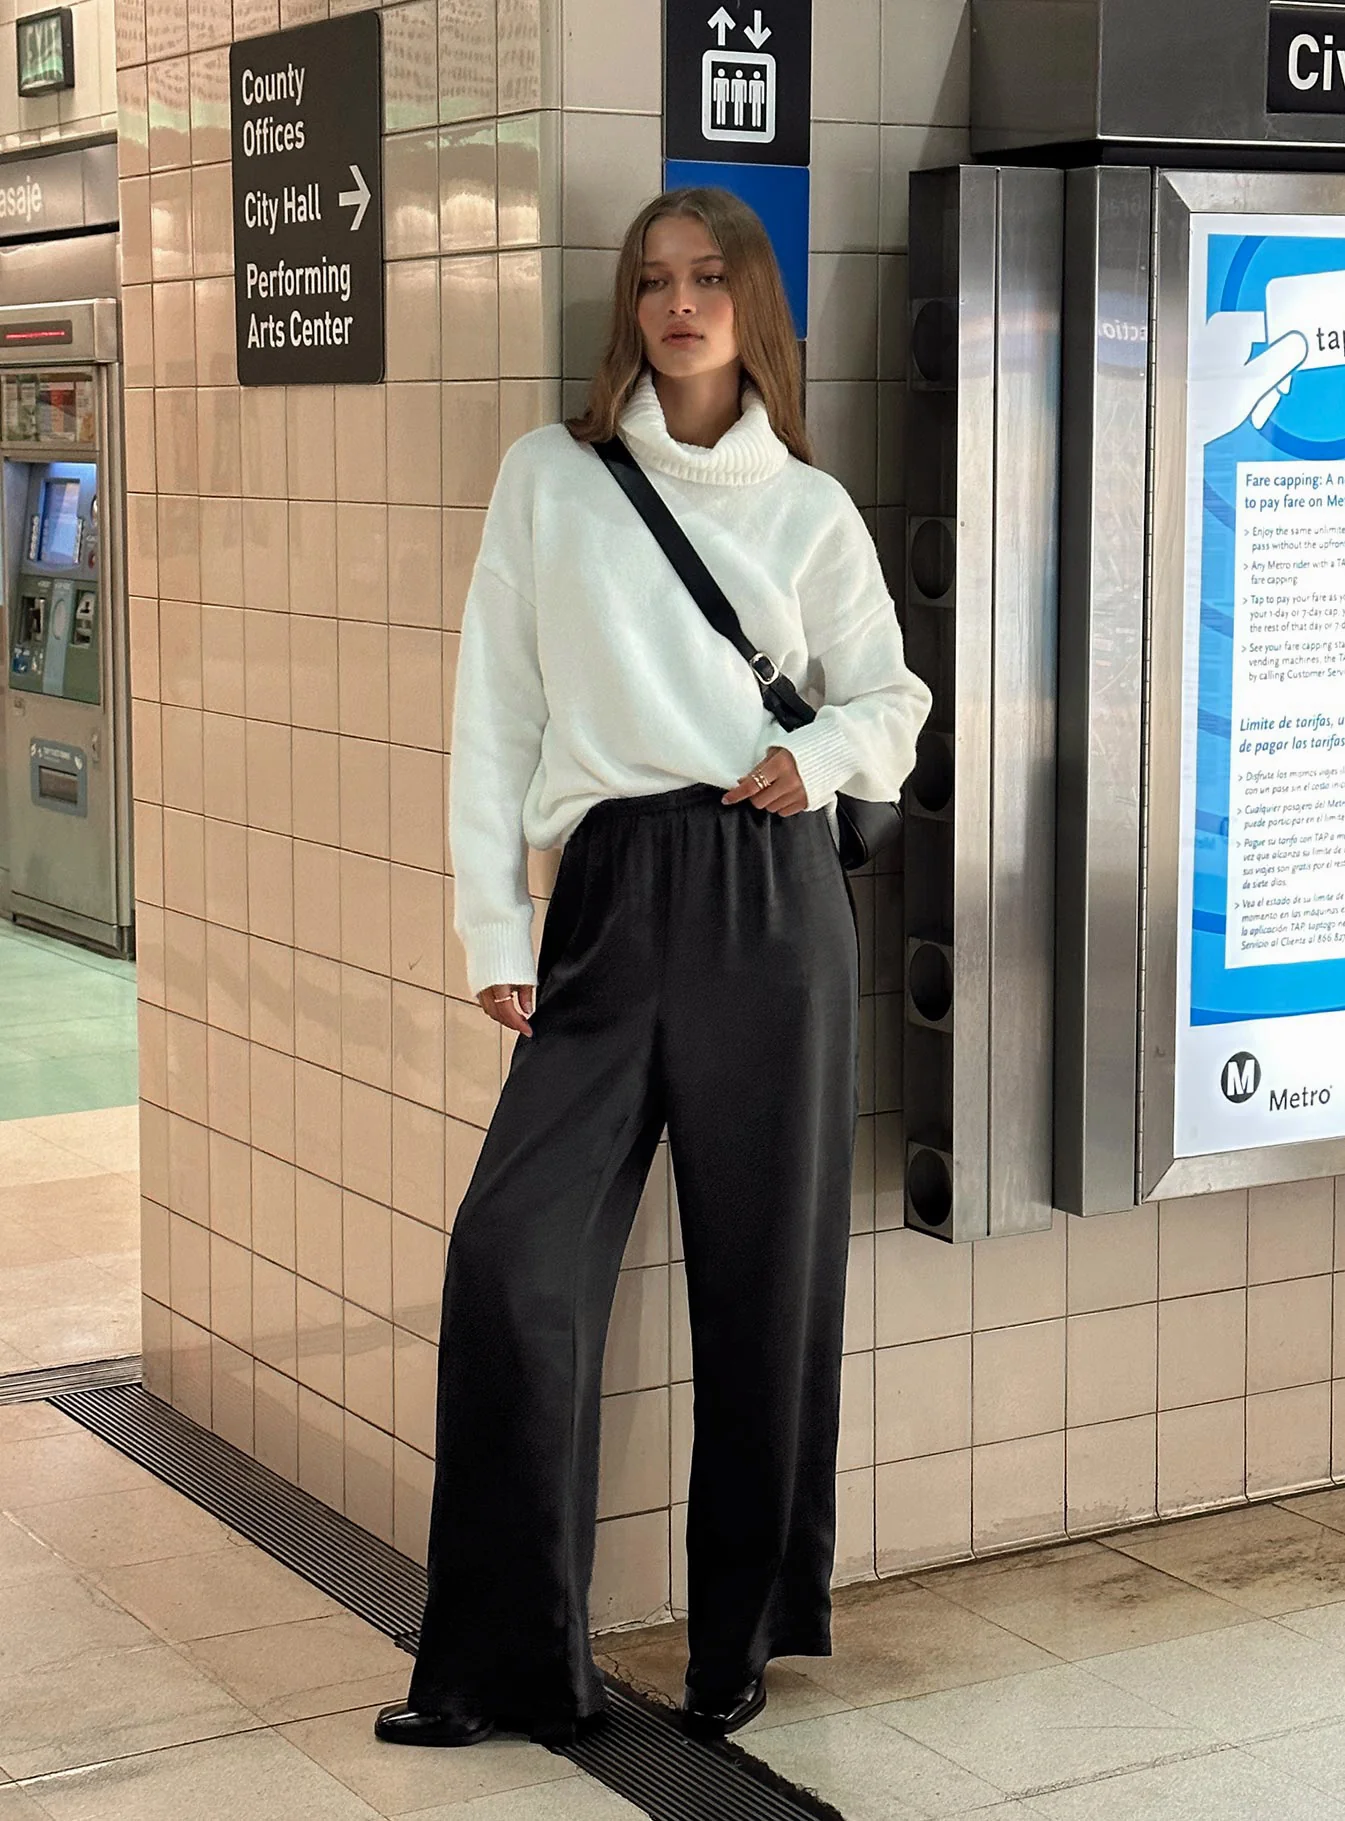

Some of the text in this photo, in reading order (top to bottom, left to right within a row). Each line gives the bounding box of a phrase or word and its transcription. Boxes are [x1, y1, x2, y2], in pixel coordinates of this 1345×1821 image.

[242, 63, 305, 106] County
[243, 116, 305, 157] Offices
[0, 175, 42, 222] asaje
[244, 183, 322, 235] City Hall
[246, 256, 351, 301] Performing
[247, 310, 354, 348] Arts Center
[1316, 327, 1345, 357] ta
[1246, 474, 1270, 487] Fare
[1274, 473, 1322, 490] capping:
[1326, 473, 1333, 485] A
[1245, 494, 1345, 512] to pay fare on Me
[1253, 526, 1273, 538] Enjoy
[1276, 527, 1288, 535] the
[1252, 539, 1345, 553] pass without the upfron
[1251, 561, 1265, 572] Any
[1268, 561, 1291, 569] Metro
[1293, 560, 1310, 568] rider
[1251, 574, 1265, 584] fare
[1250, 595, 1264, 606] Tap
[1266, 596, 1274, 604] to
[1277, 596, 1290, 605] pay
[1293, 596, 1310, 604] your
[1312, 592, 1326, 602] fare
[1250, 611, 1267, 621] your
[1270, 608, 1288, 619] 1-day
[1302, 608, 1322, 618] 7-day
[1250, 624, 1262, 632] the
[1264, 624, 1279, 632] rest
[1281, 621, 1290, 631] of
[1291, 623, 1307, 631] that
[1309, 622, 1322, 630] day
[1249, 643, 1263, 652] See
[1265, 644, 1281, 654] your
[1285, 641, 1299, 650] fare
[1302, 642, 1332, 651] capping
[1249, 656, 1279, 668] vending
[1249, 672, 1257, 682] by
[1259, 671, 1284, 682] calling
[1287, 670, 1325, 679] Customer
[1279, 716, 1292, 729] de
[1296, 713, 1333, 731] tarifas,
[1239, 734, 1345, 756] de pagar las tarifas
[1246, 770, 1274, 783] Disfrute
[1276, 770, 1287, 779] los
[1272, 786, 1289, 795] pase
[1245, 804, 1281, 815] Cualquier
[1282, 804, 1312, 814] pasajero
[1244, 819, 1266, 830] puede
[1268, 818, 1304, 829] participar
[1244, 838, 1265, 850] Pague
[1278, 834, 1297, 847] tarifa
[1315, 832, 1329, 841] TAP
[1256, 853, 1269, 861] que
[1272, 850, 1300, 859] alcanza
[1334, 846, 1341, 854] de
[1243, 868, 1253, 876] sus
[1255, 864, 1275, 876] viajes
[1292, 864, 1311, 874] gratis
[1313, 863, 1325, 871] por
[1326, 860, 1332, 868] el
[1252, 880, 1268, 888] siete
[1242, 899, 1255, 908] Vea
[1257, 898, 1264, 907] el
[1266, 896, 1290, 906] estado
[1293, 896, 1301, 904] de
[1242, 913, 1277, 922] momento
[1292, 910, 1301, 918] las
[1241, 926, 1248, 936] la
[1241, 940, 1269, 950] Servicio
[1271, 938, 1279, 947] al
[1281, 937, 1306, 946] Cliente
[1308, 935, 1315, 944] al
[1317, 934, 1332, 943] 866
[1269, 1086, 1331, 1112] Metro
